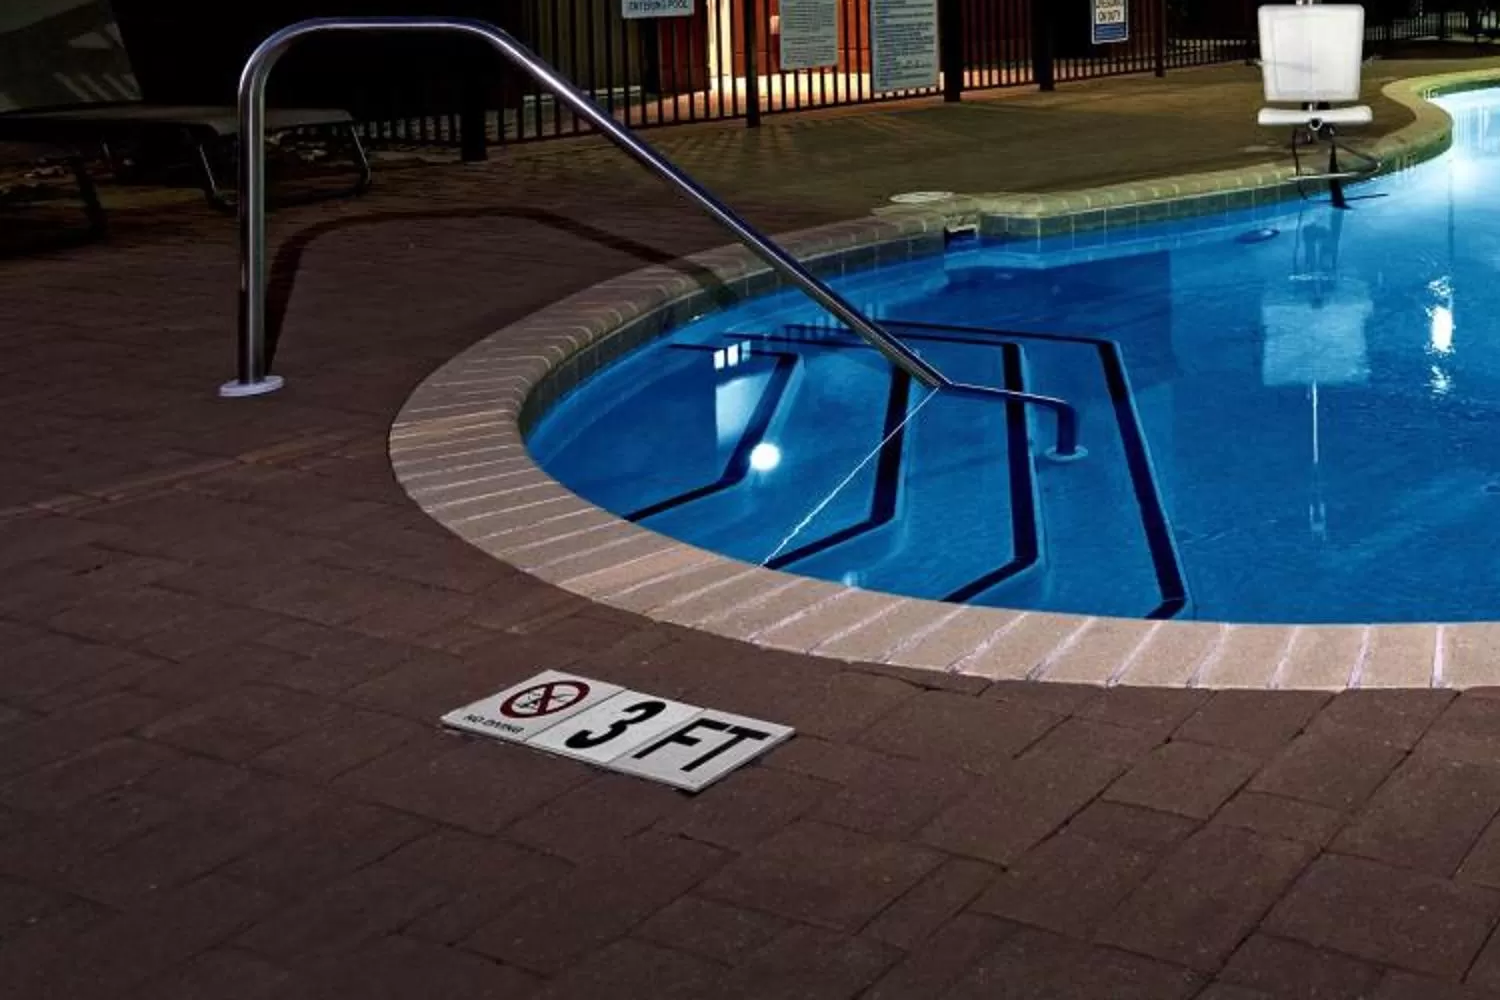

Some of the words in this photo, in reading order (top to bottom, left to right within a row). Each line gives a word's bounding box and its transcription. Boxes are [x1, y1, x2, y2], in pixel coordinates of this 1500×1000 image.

[463, 714, 485, 723] NO
[565, 700, 667, 749] 3
[632, 718, 771, 772] FT
